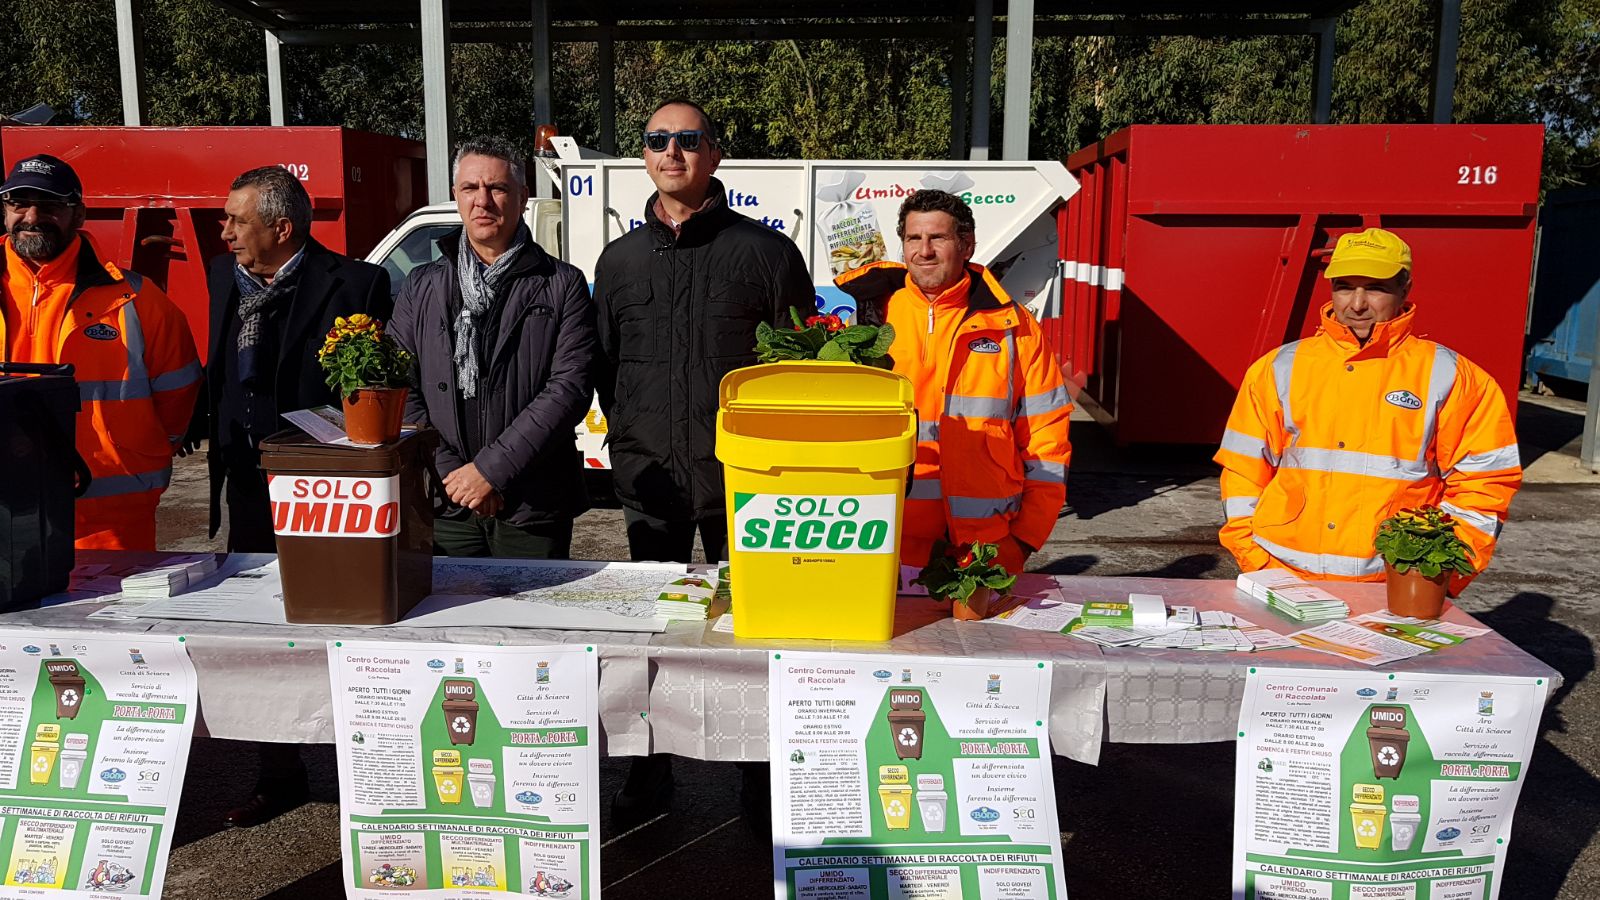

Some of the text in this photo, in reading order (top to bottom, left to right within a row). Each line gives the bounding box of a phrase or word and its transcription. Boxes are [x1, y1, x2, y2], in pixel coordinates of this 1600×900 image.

[278, 164, 308, 180] 02
[1457, 166, 1498, 184] 216
[570, 175, 593, 196] 01
[960, 192, 1016, 206] Secco
[832, 218, 861, 231] RACCOLTA
[828, 224, 872, 241] DIFFERENZIATA
[830, 232, 874, 250] RIFIUTO UMIDO
[1388, 394, 1420, 406] Bono
[292, 478, 372, 500] SOLO
[774, 497, 860, 516] SOLO
[271, 501, 398, 534] UMIDO
[742, 518, 888, 550] SECCO
[446, 686, 473, 694] UMIDO
[892, 694, 920, 704] UMIDO
[114, 706, 140, 718] PORTA
[148, 707, 175, 718] PORTA
[1372, 712, 1404, 722] UMIDO
[512, 733, 540, 743] PORTA
[548, 732, 578, 742] PORTA
[962, 744, 991, 754] PORTA
[999, 744, 1028, 754] PORTA
[1442, 764, 1472, 776] PORTA
[1480, 766, 1508, 776] PORTA
[1, 806, 52, 817] SETTIMANALE
[63, 811, 103, 820] RACCOLTA
[104, 812, 118, 820] DEI
[118, 814, 148, 822] RIFIUTI
[1013, 808, 1034, 818] sea
[95, 825, 146, 834] INDIFFERENZIATO
[418, 824, 474, 832] SETTIMANALE
[486, 826, 528, 836] RACCOLTA
[524, 841, 575, 850] INDIFFERENZIATO
[799, 856, 858, 866] CALENDARIO
[862, 856, 925, 864] SETTIMANALE
[940, 854, 986, 862] RACCOLTA
[1008, 854, 1038, 862] RIFIUTI
[1260, 864, 1322, 878] CALENDARIO
[1326, 871, 1388, 882] SETTIMANALE
[1402, 870, 1441, 880] RACCOLTA
[1456, 866, 1482, 874] RIFIUTI
[1282, 880, 1306, 888] UMIDO
[1436, 878, 1482, 888] INDIFFERENZIATO
